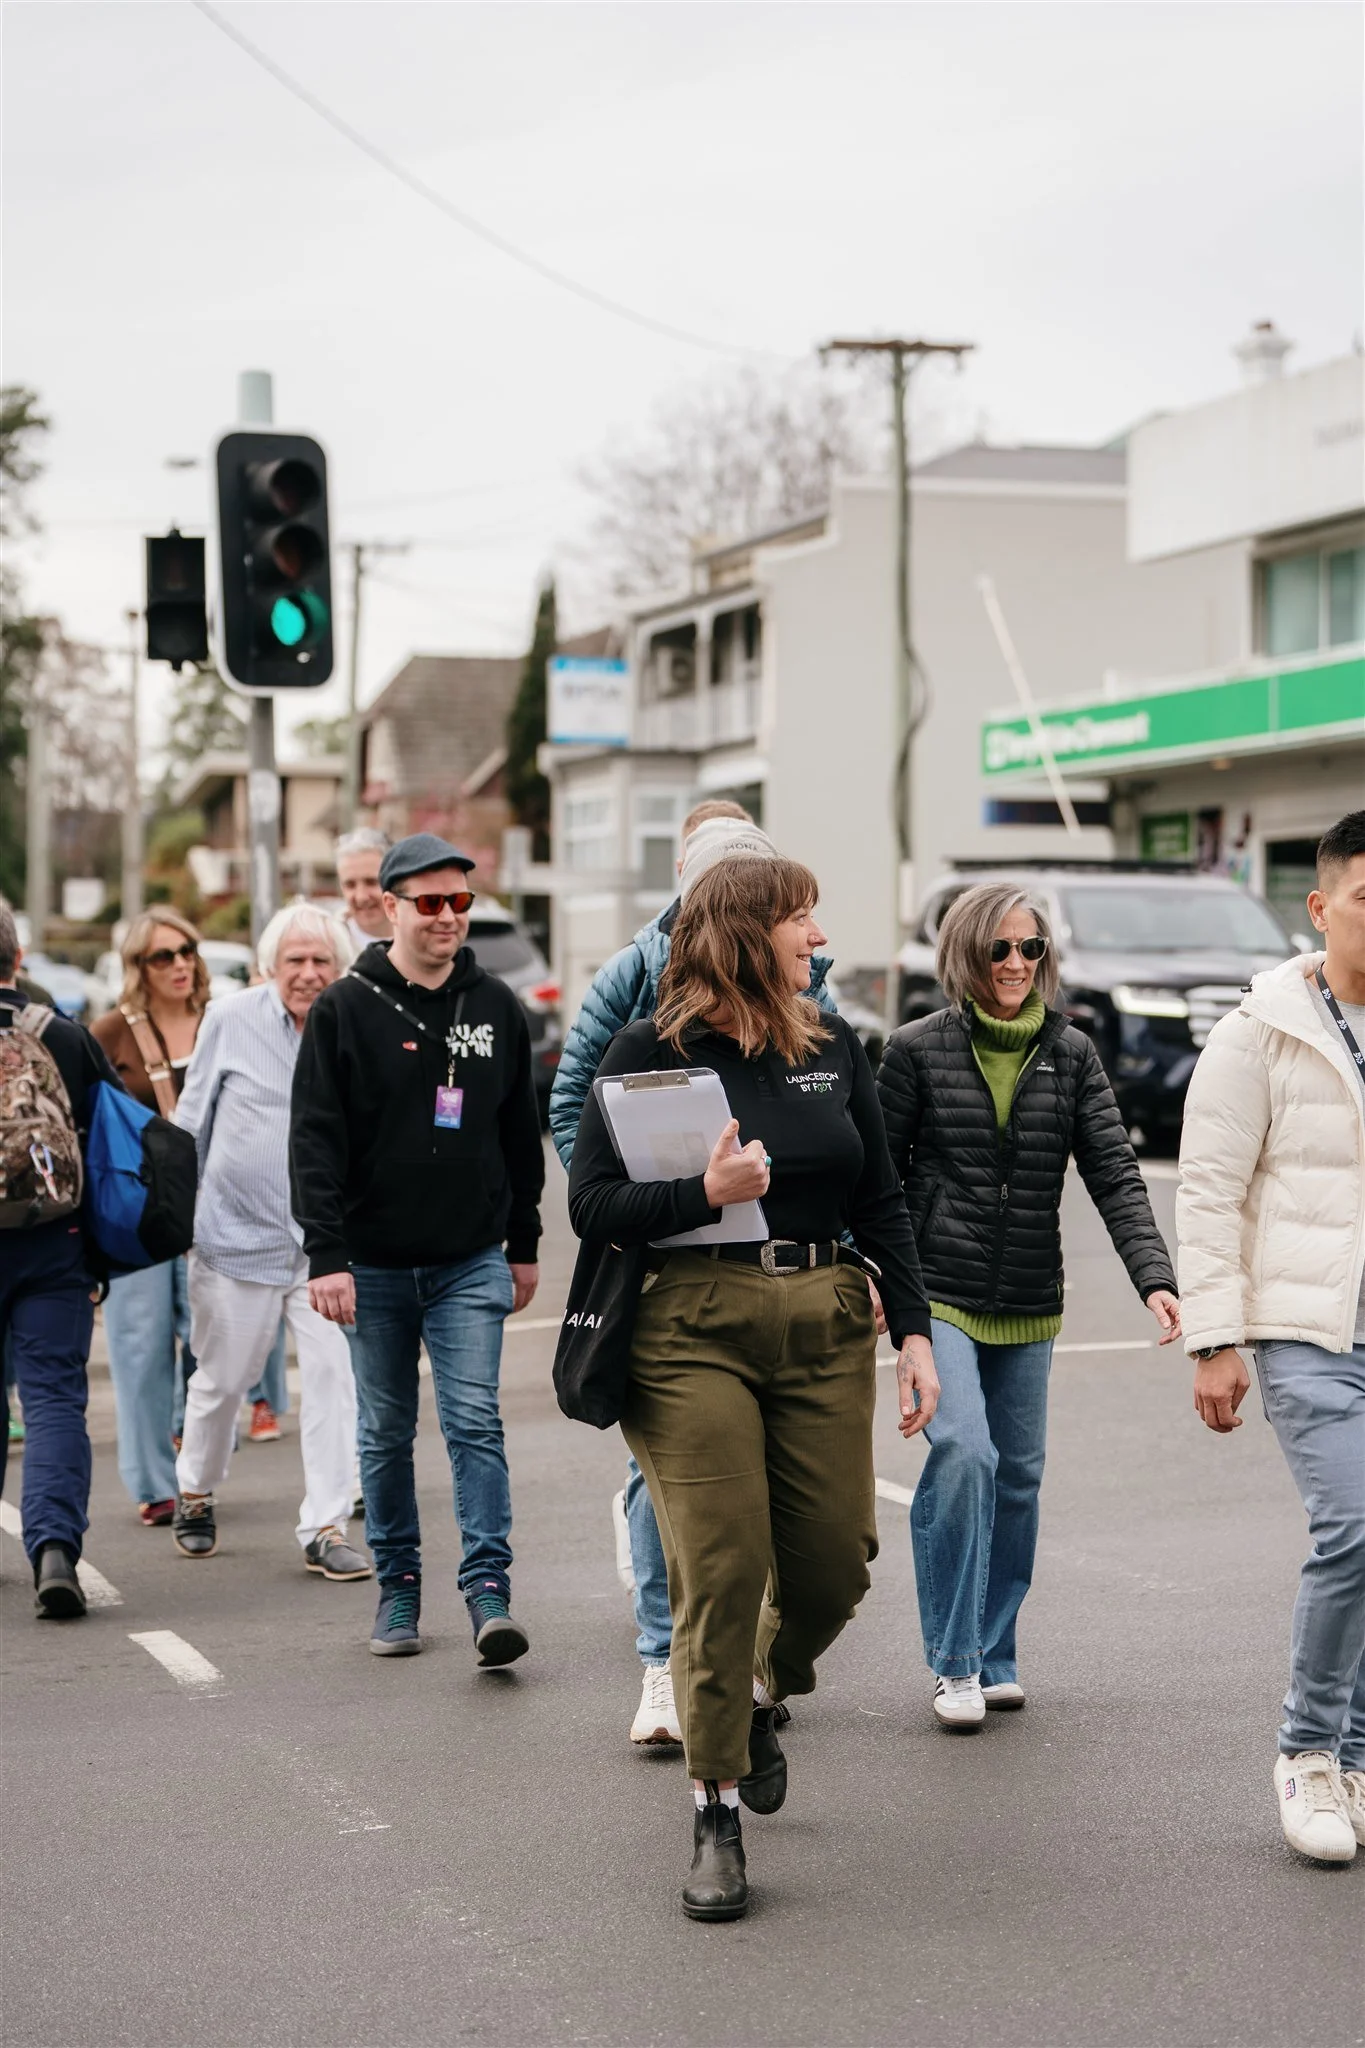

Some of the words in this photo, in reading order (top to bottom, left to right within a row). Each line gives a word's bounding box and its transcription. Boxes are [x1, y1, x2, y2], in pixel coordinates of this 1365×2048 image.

[785, 1072, 839, 1084] LAUNCESTON
[800, 1083, 811, 1092] BY
[812, 1082, 833, 1093] FOOT
